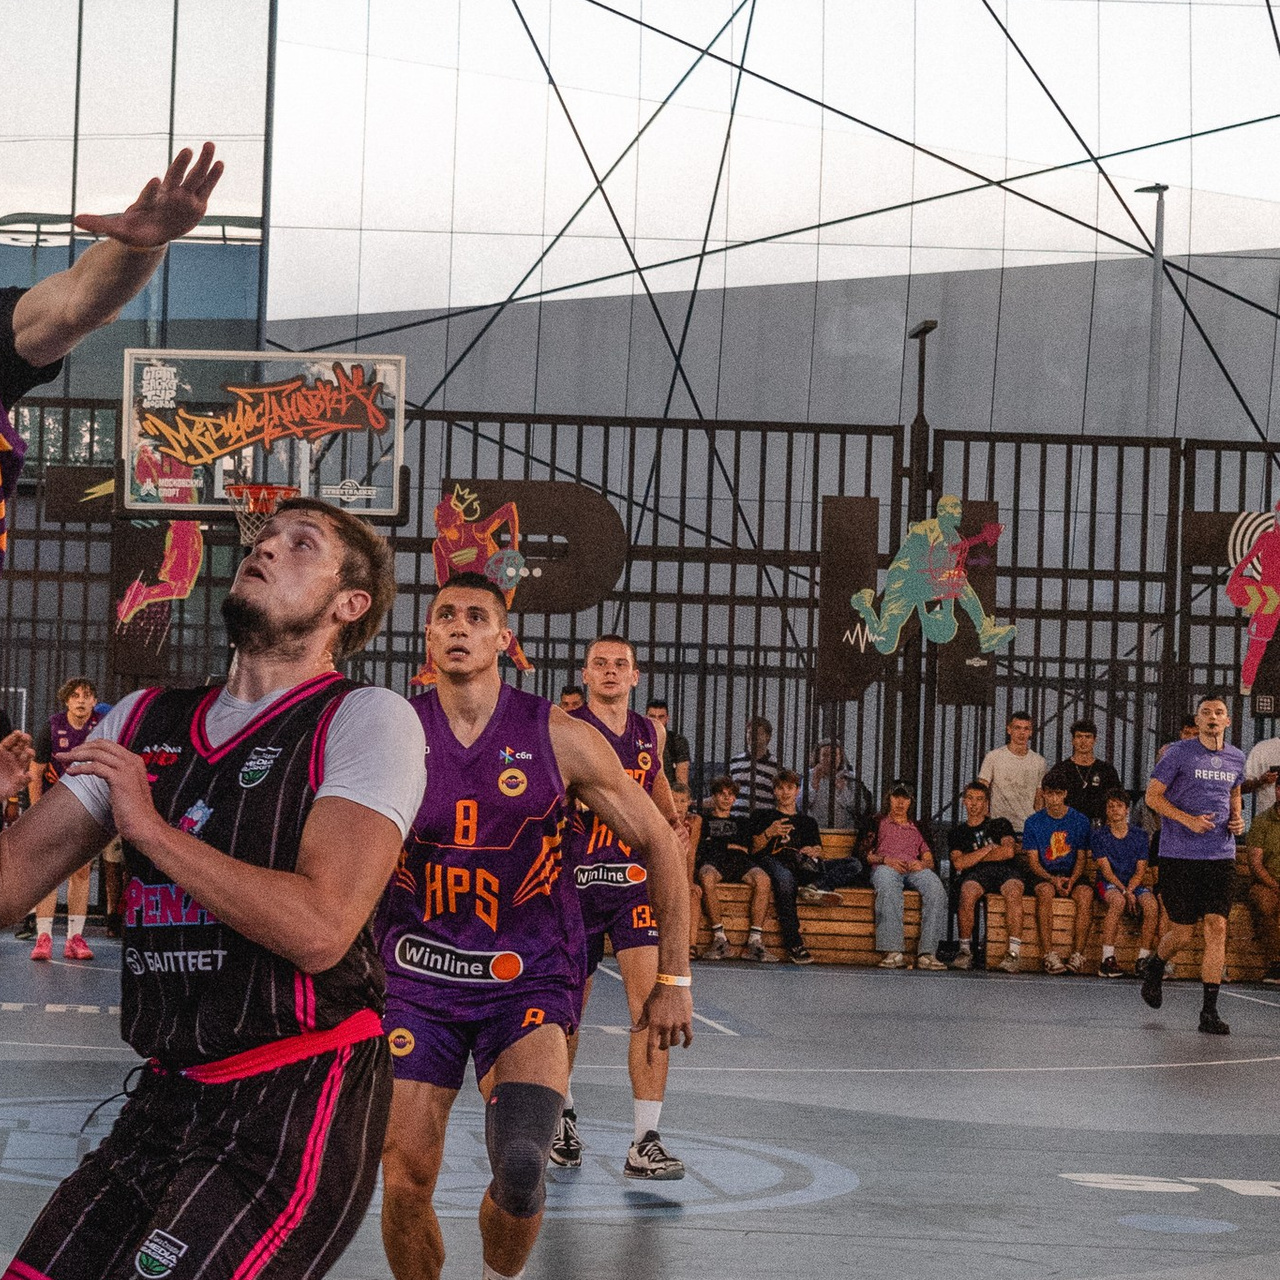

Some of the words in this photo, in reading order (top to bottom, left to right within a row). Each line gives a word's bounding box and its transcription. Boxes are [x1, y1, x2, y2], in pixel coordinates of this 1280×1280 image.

[453, 799, 479, 846] 8
[576, 867, 625, 884] Winline
[422, 861, 501, 933] HPS
[404, 942, 484, 976] Winline
